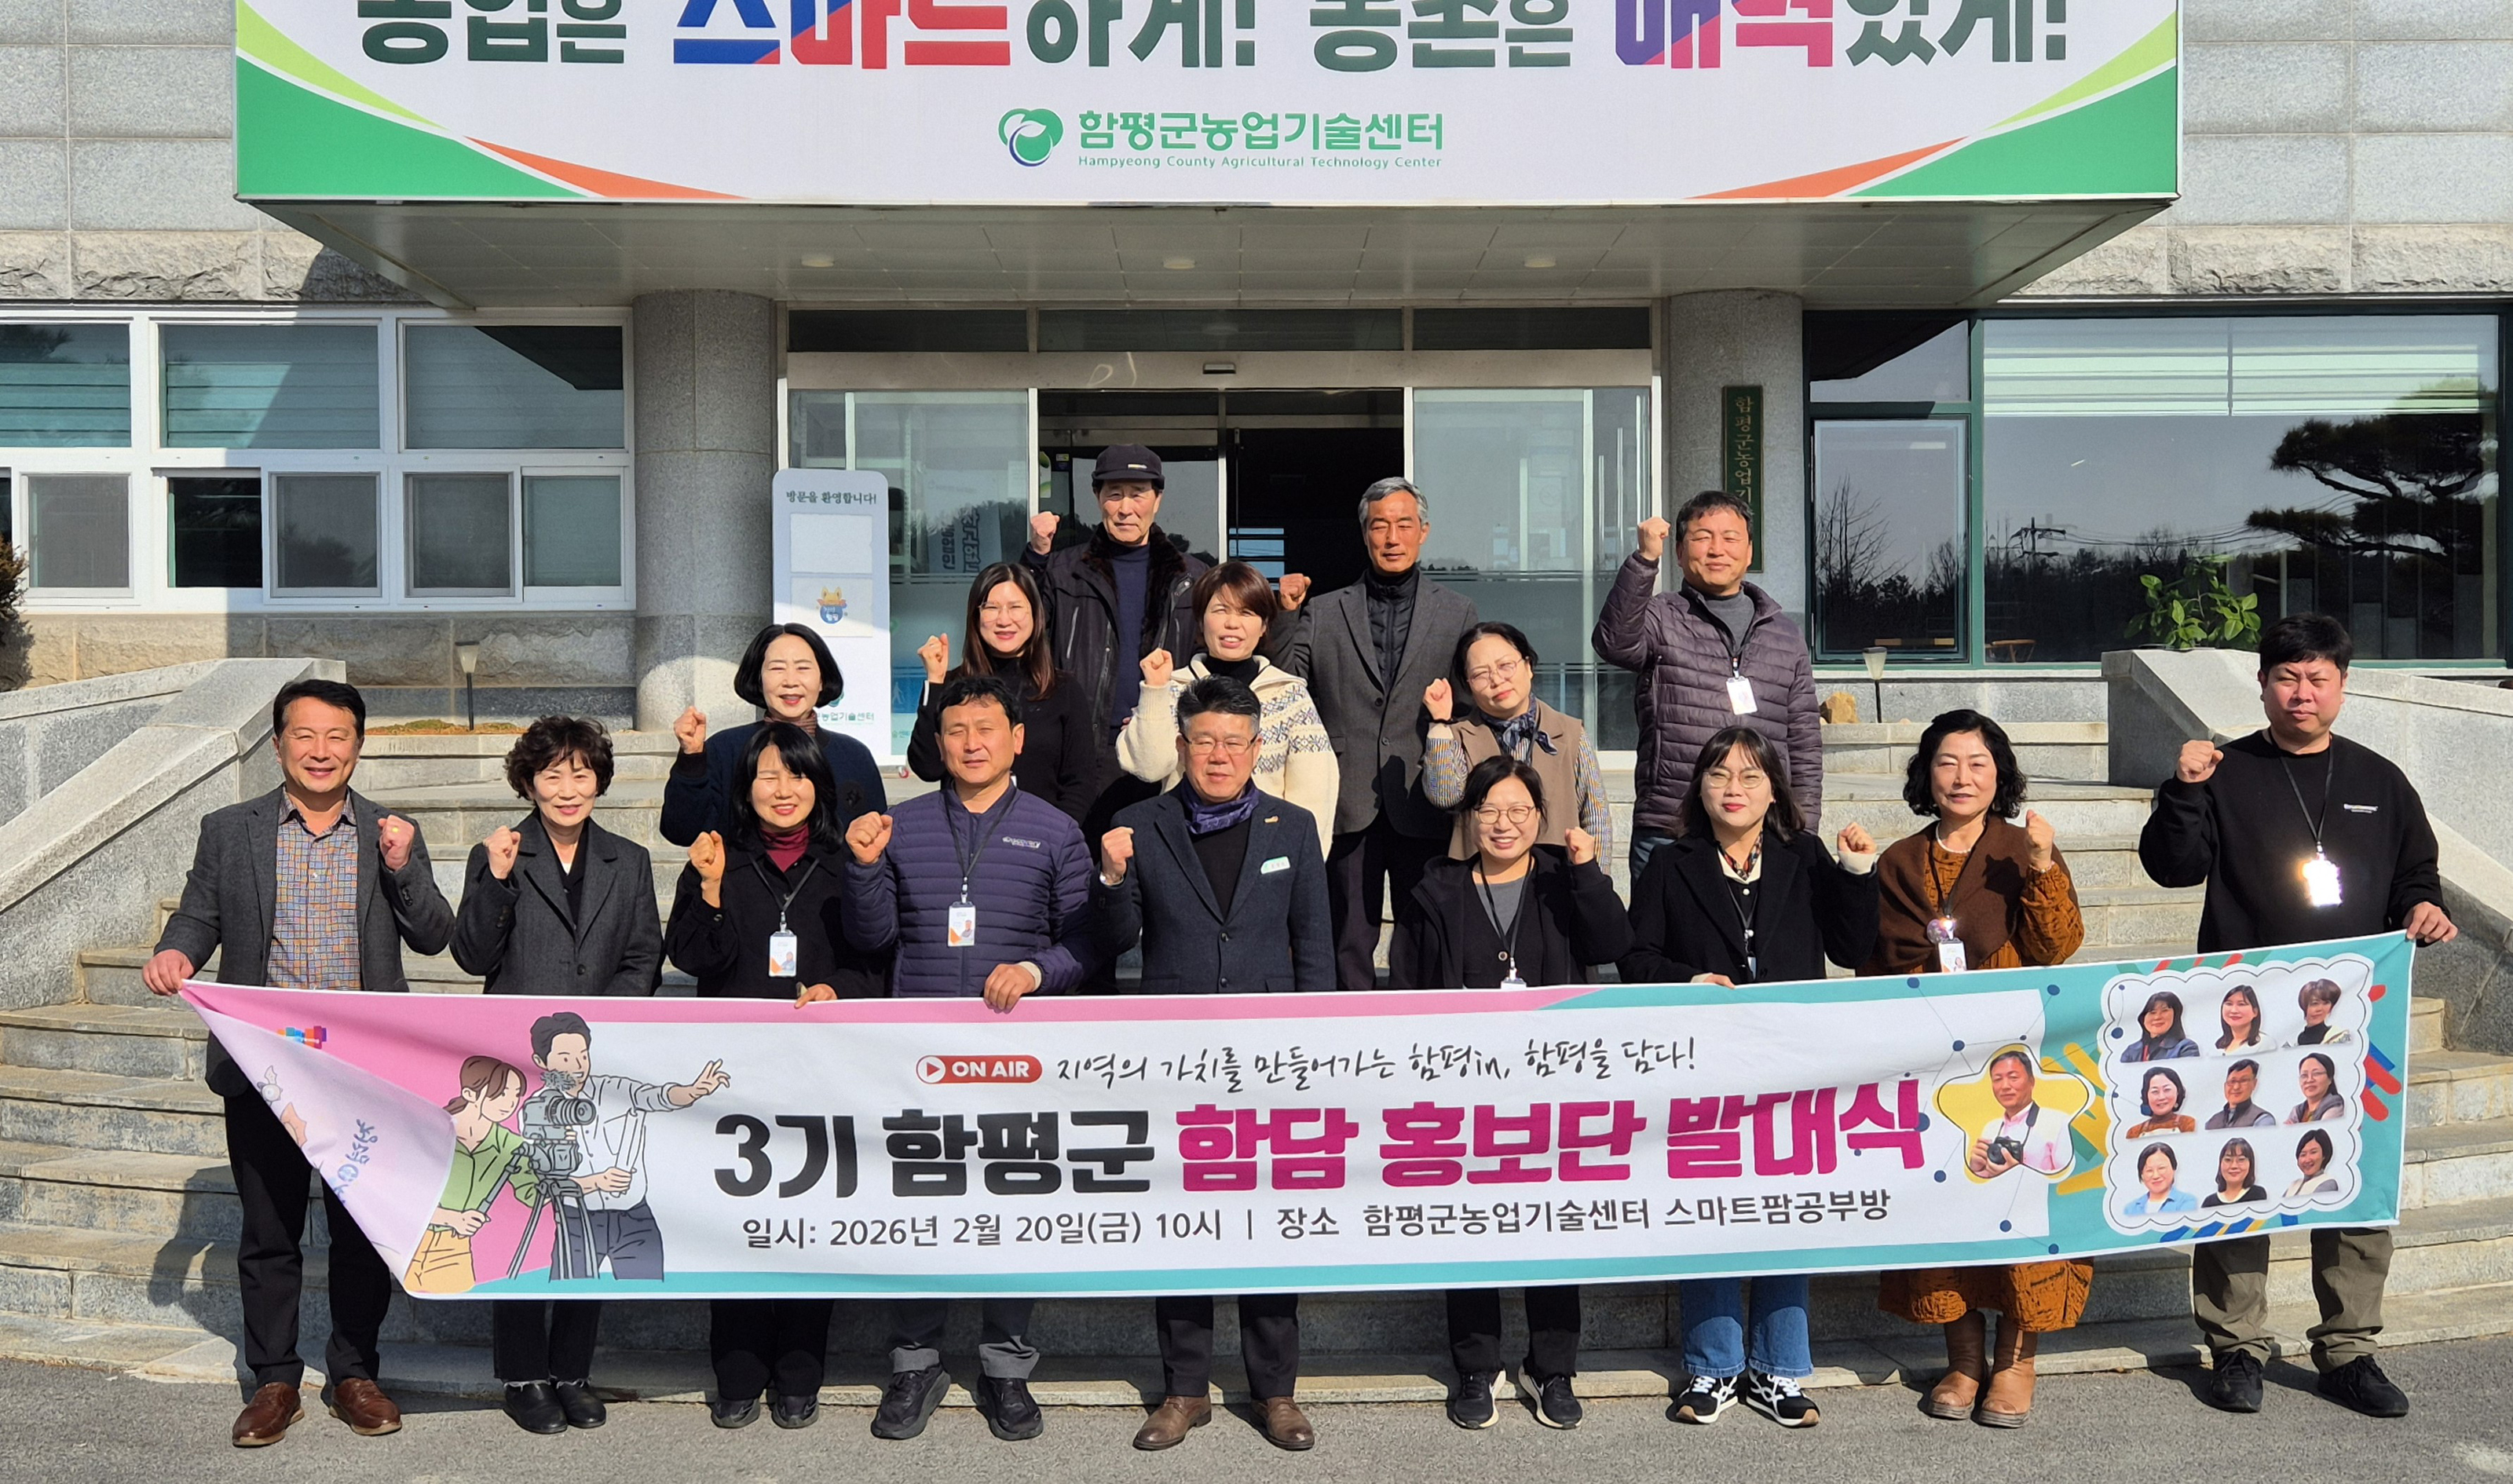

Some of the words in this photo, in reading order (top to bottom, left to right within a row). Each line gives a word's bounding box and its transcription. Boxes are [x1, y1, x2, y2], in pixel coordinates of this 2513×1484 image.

[1078, 110, 1443, 151] 함평군농업기술센터
[1078, 155, 1160, 168] Hampyeong
[1167, 155, 1215, 168] County
[1221, 155, 1304, 168] Agricultural
[1311, 155, 1389, 169] Technology
[1395, 156, 1441, 167] Center
[1735, 397, 1754, 503] 함평군농업기
[786, 491, 818, 503] 방문을
[821, 492, 876, 505] 환영합니다!
[952, 1061, 986, 1078] ON
[991, 1060, 1030, 1078] AIR
[1057, 1053, 1147, 1089] 지역의
[1161, 1047, 1243, 1093] 가치를
[1254, 1046, 1396, 1091] 만들어가는
[1408, 1043, 1510, 1080] 함평in,
[1524, 1037, 1611, 1080] 함평을
[1621, 1036, 1695, 1074] 담다!
[714, 1113, 858, 1198] 3기
[881, 1108, 1155, 1197] 함평군
[1176, 1103, 1359, 1192] 함담
[1379, 1100, 1647, 1188] 홍보단
[1666, 1079, 1926, 1180] 발대식
[742, 1219, 816, 1249] 일시:
[829, 1215, 939, 1247] 2026년
[953, 1213, 1002, 1246] 2월
[1015, 1212, 1142, 1245] 20일(금)
[1155, 1208, 1223, 1242] 10시
[1276, 1206, 1341, 1237] 장소
[1363, 1198, 1651, 1237] 함평군농업기술센터
[1664, 1189, 1891, 1230] 스마트팜공부방
